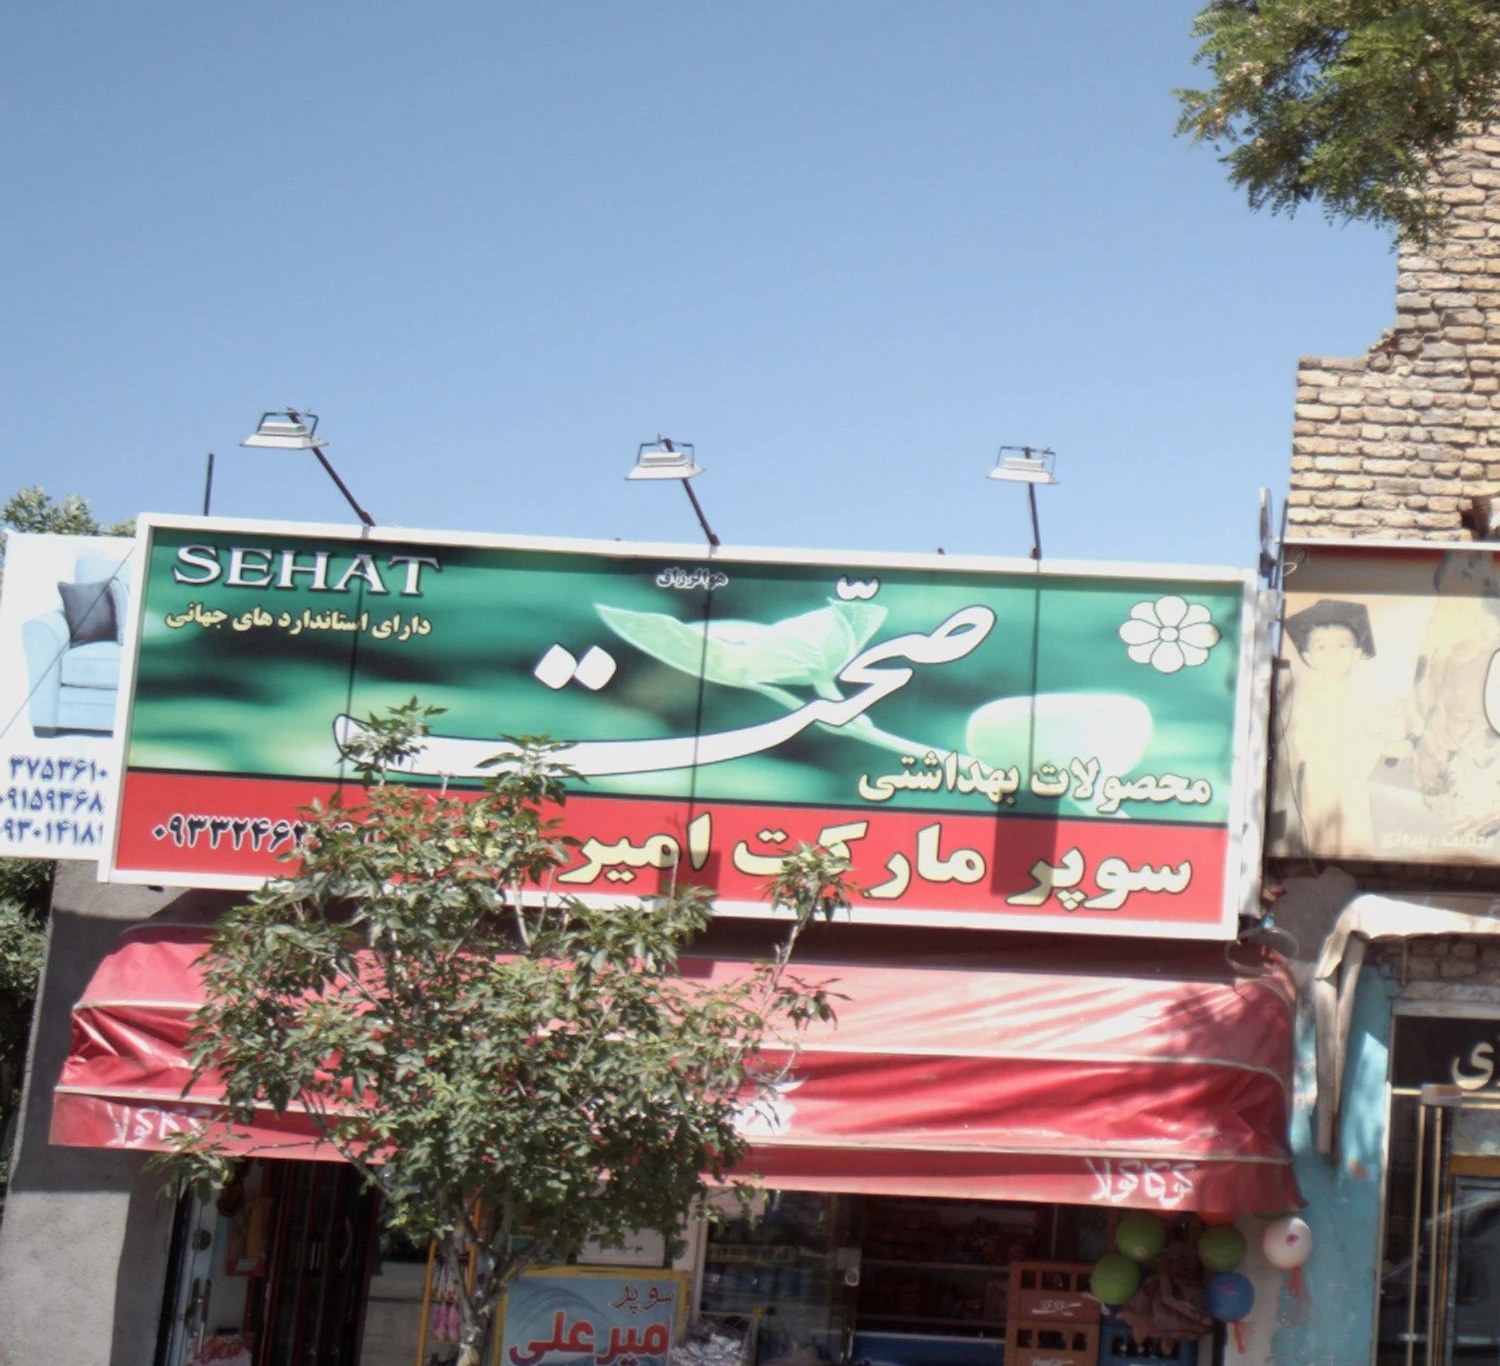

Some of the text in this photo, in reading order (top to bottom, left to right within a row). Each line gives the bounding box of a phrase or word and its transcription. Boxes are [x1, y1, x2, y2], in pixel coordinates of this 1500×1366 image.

[172, 543, 443, 598] SEHAT
[165, 601, 432, 641] دارای استاندارد های جهانی
[858, 749, 1213, 814] محصولات بهداشتی
[556, 810, 1193, 912] سوپر مارکت امیر
[610, 1286, 674, 1315] سوپر
